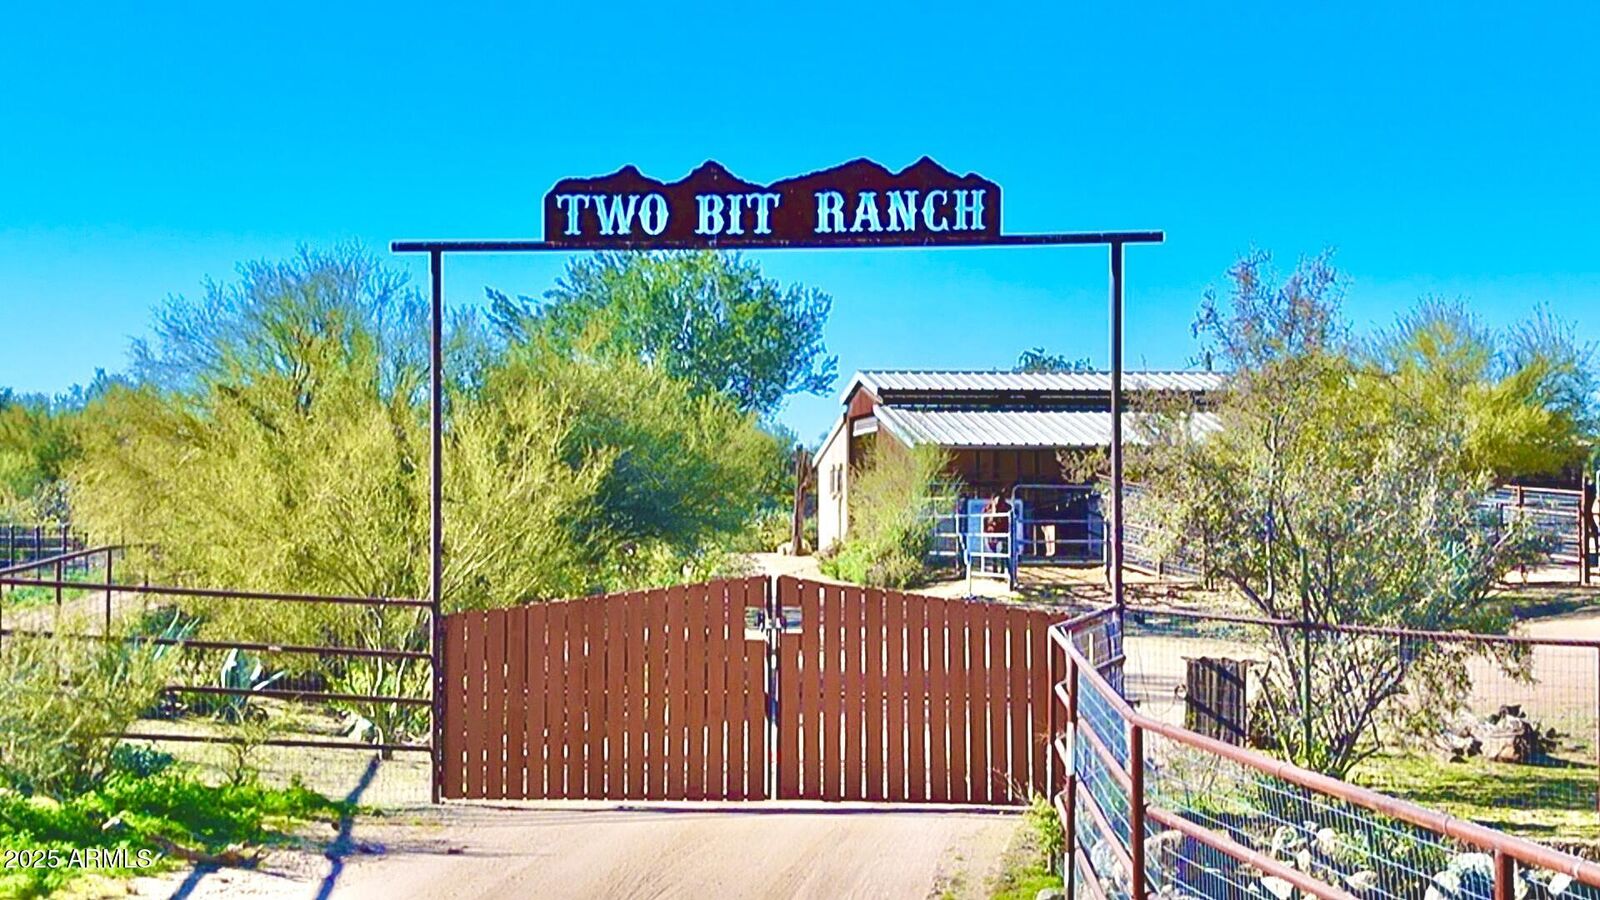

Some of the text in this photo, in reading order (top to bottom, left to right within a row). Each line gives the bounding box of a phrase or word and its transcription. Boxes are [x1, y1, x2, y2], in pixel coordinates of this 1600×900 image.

[556, 190, 987, 236] TWO BIT RANCH
